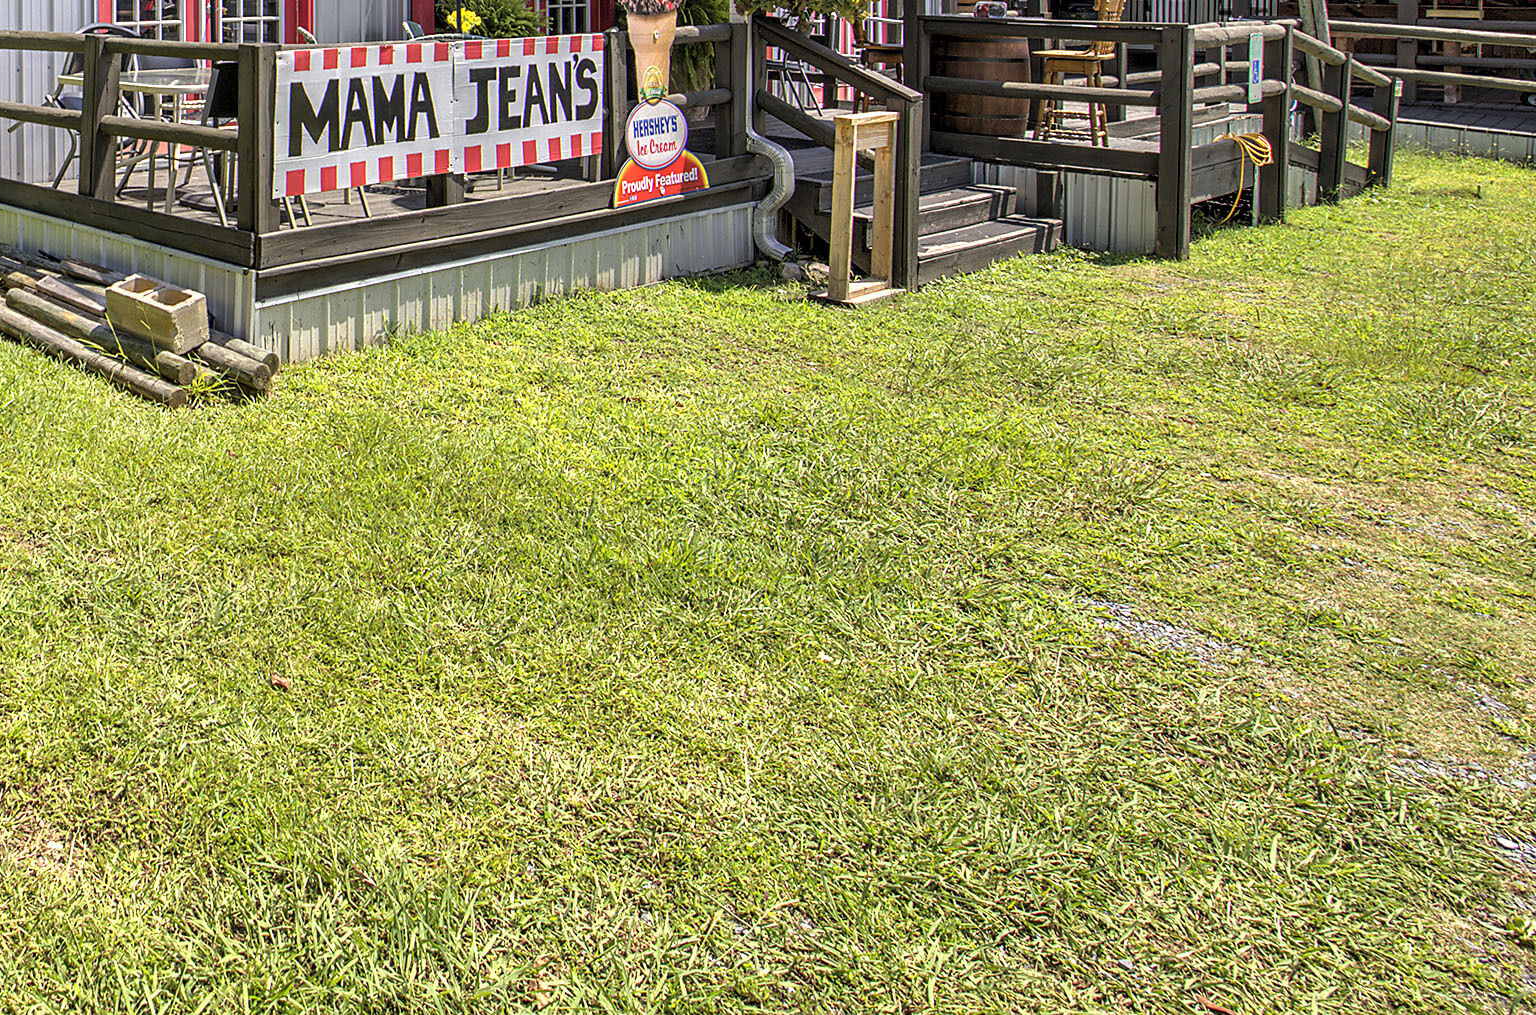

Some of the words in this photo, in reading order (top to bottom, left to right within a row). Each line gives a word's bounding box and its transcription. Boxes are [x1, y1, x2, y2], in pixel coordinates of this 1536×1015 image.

[288, 72, 440, 158] MAMA
[465, 53, 599, 135] JEAN'S
[633, 115, 678, 139] HERSHEY'S
[637, 139, 648, 157] Ice
[650, 138, 677, 155] Cream
[622, 175, 654, 195] Proudly
[655, 167, 699, 188] Featured!
